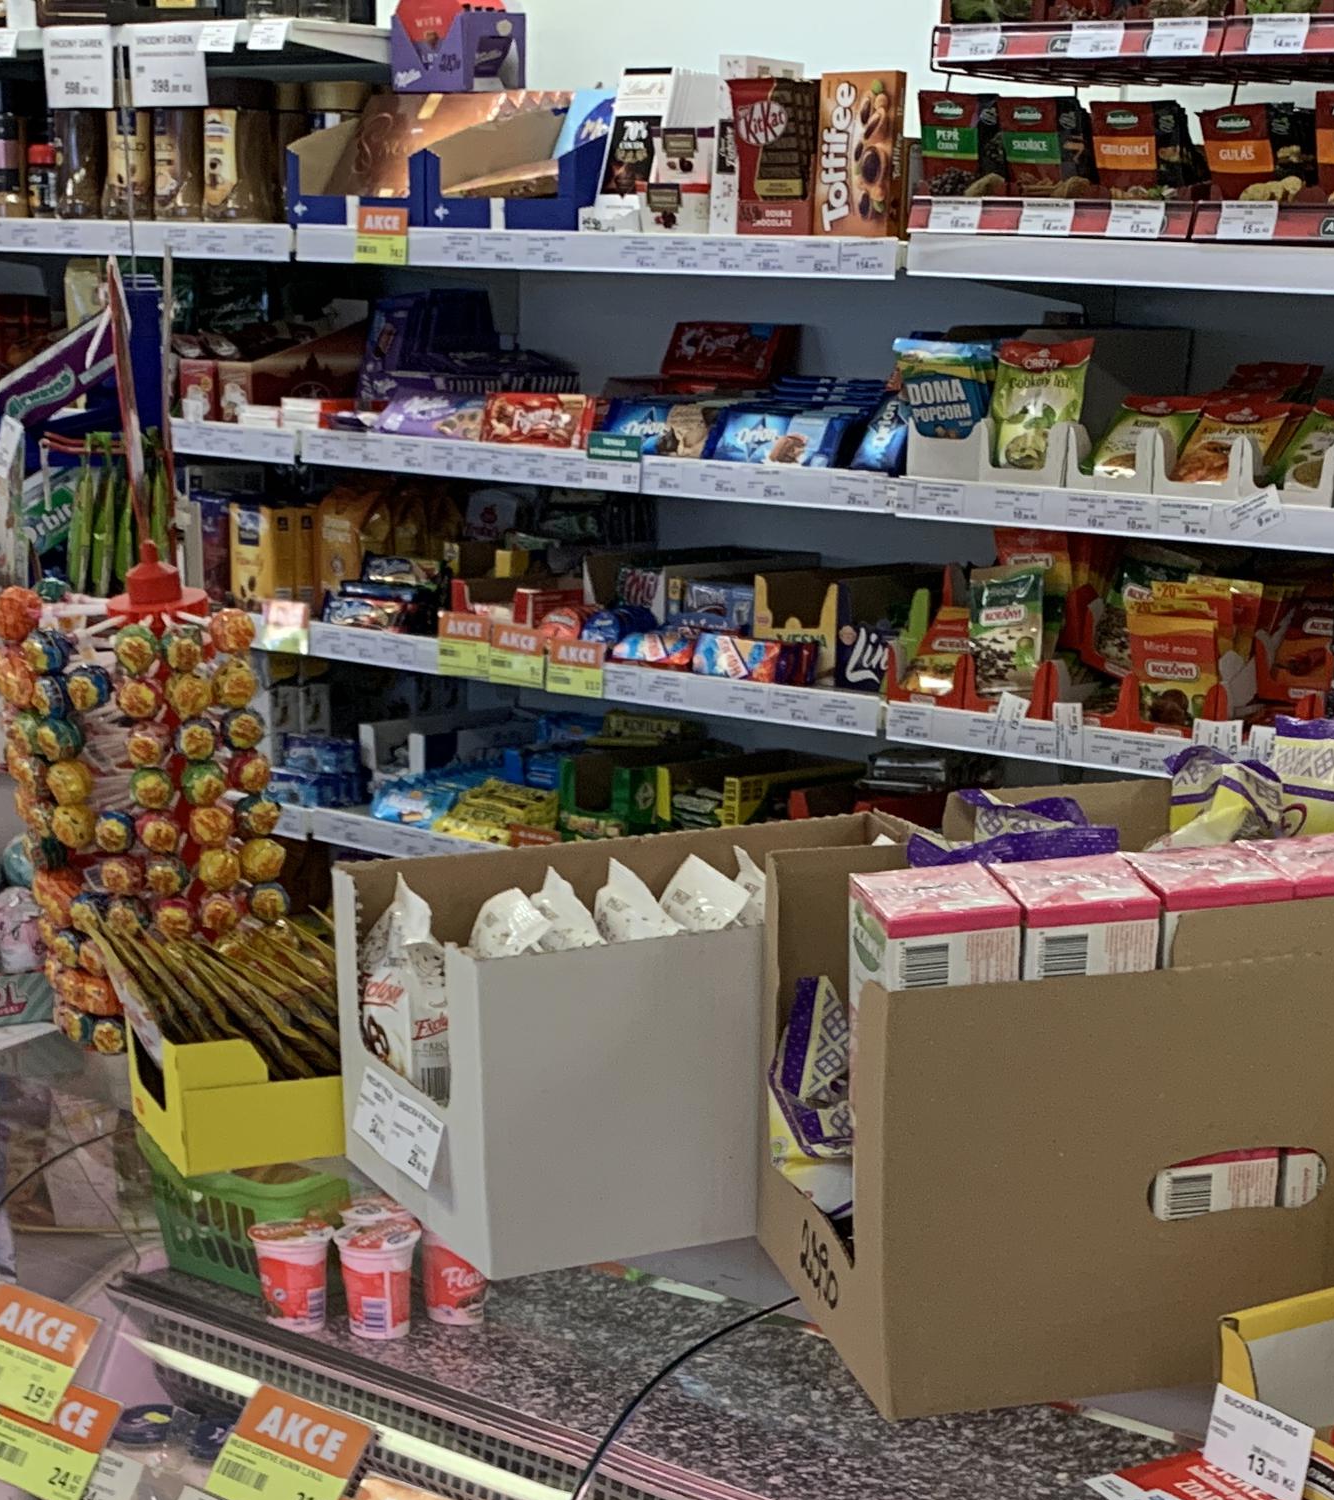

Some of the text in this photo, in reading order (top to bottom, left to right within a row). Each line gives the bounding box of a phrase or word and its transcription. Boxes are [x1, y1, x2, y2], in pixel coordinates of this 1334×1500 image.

[822, 82, 857, 231] Toffifee
[1219, 146, 1255, 161] GULÁŠ
[365, 214, 401, 230] AKCE
[908, 382, 963, 404] DOMA
[913, 404, 971, 421] POPCORN
[736, 416, 778, 446] Orion
[446, 619, 485, 639] AKCE
[499, 632, 538, 652] AKCE
[558, 644, 598, 665] AKCE
[255, 1406, 347, 1462] AKCE
